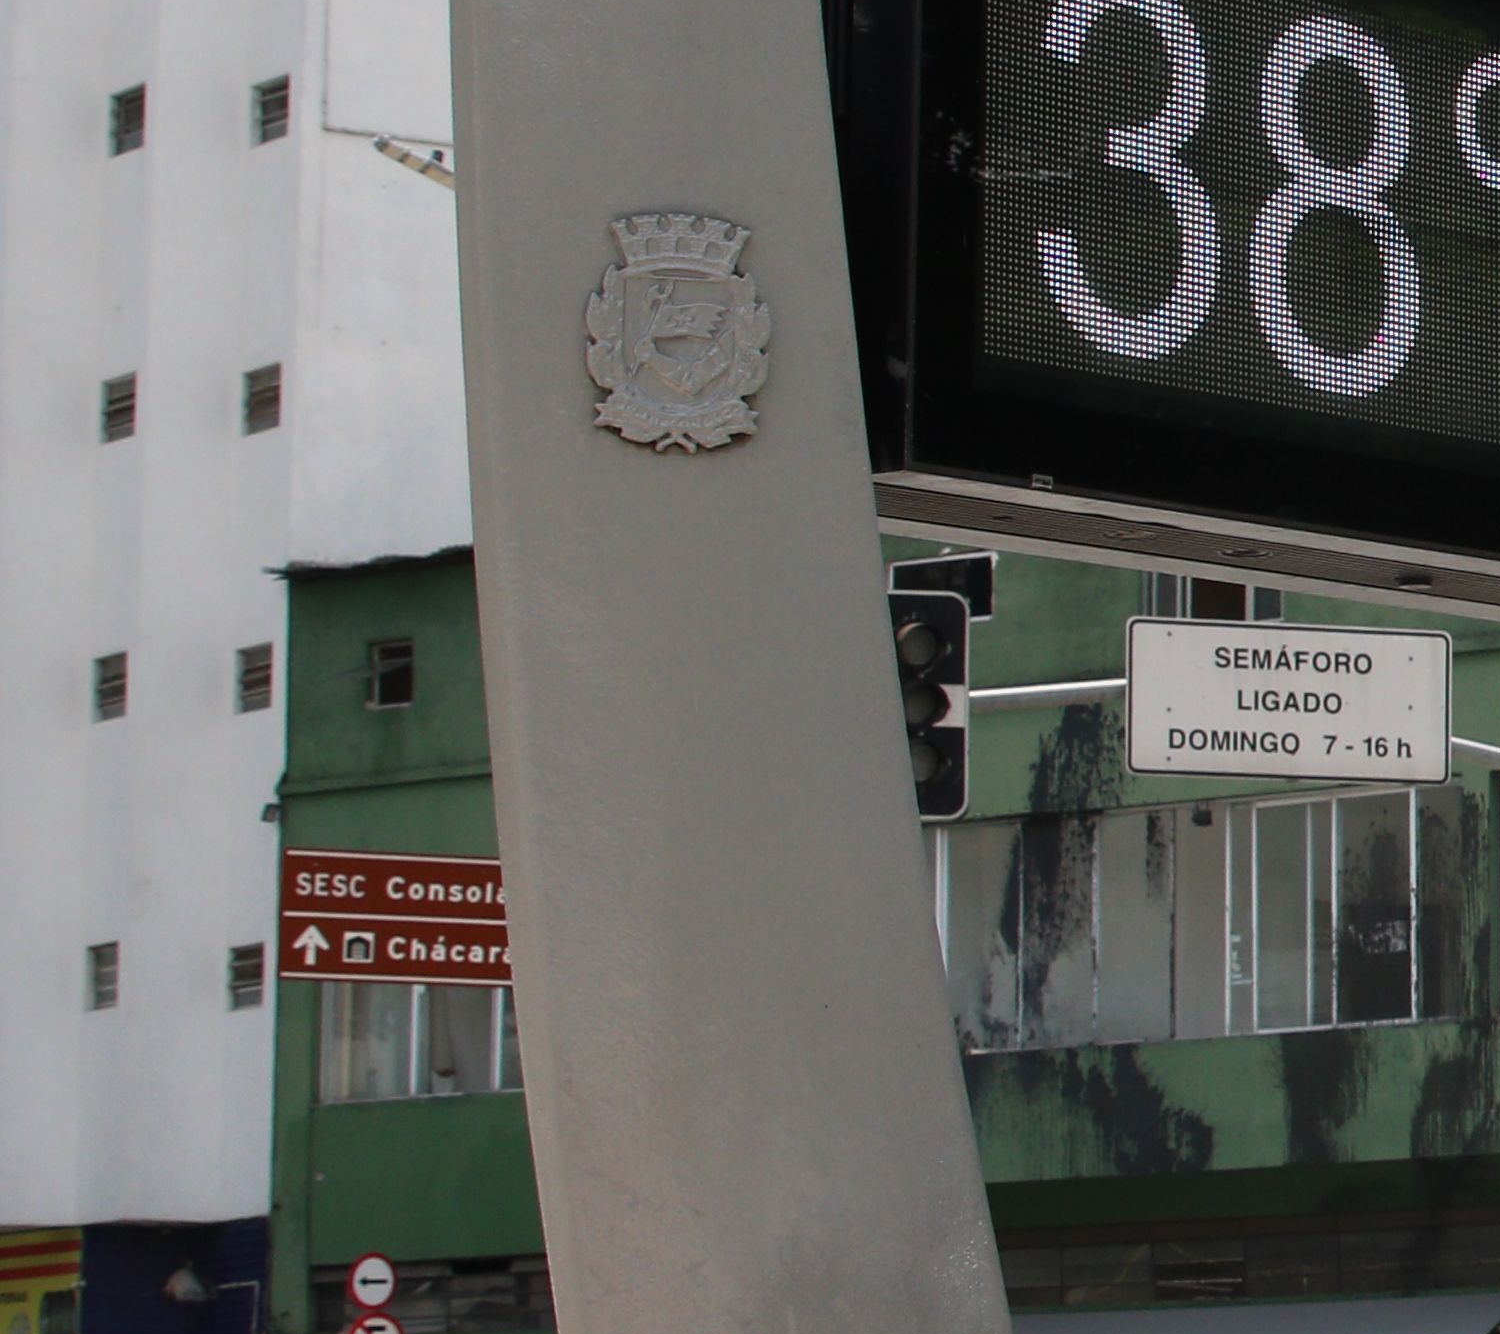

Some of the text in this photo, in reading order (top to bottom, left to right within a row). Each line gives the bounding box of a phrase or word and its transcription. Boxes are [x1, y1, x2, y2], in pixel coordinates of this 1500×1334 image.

[1214, 644, 1374, 675] SEMÁFORO
[1237, 689, 1343, 715] LIGADO
[1168, 728, 1300, 755] DOMINGO
[1323, 735, 1338, 755] 7
[1364, 737, 1389, 758] 16
[1397, 737, 1412, 759] h
[296, 872, 366, 898] SESC
